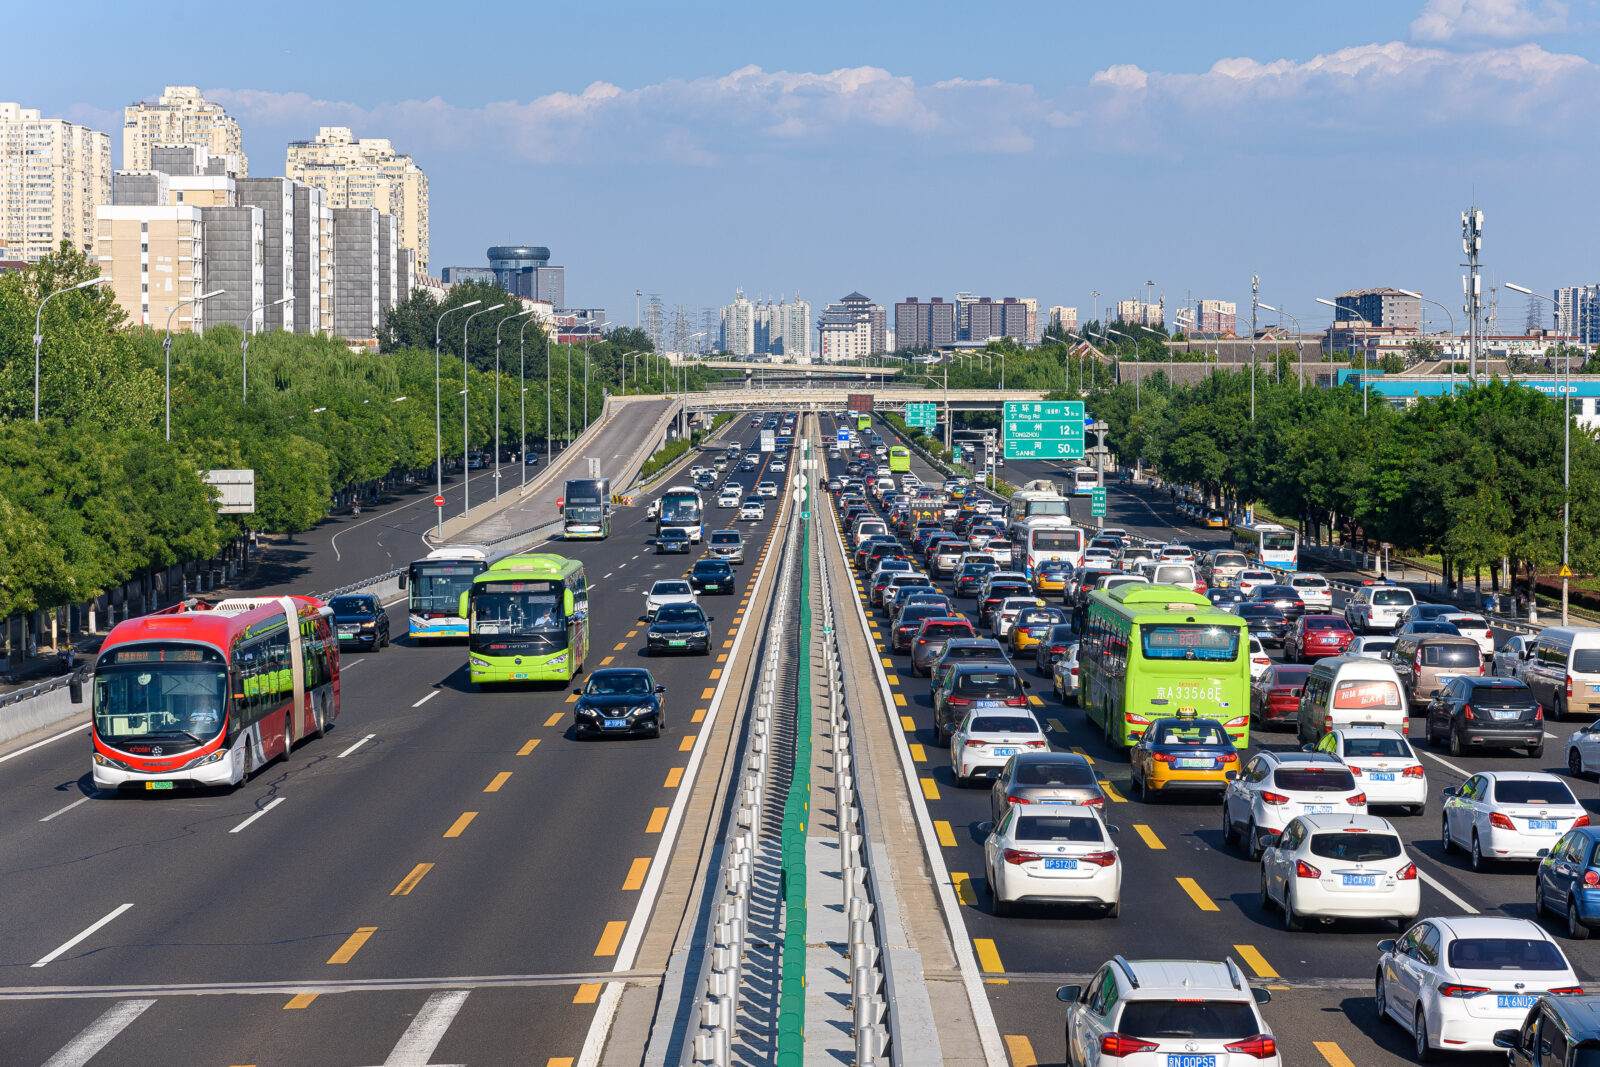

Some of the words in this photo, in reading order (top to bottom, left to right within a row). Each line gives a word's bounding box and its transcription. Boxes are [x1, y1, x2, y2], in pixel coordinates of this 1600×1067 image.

[1009, 404, 1042, 413] 五环路
[1009, 441, 1042, 450] 三河
